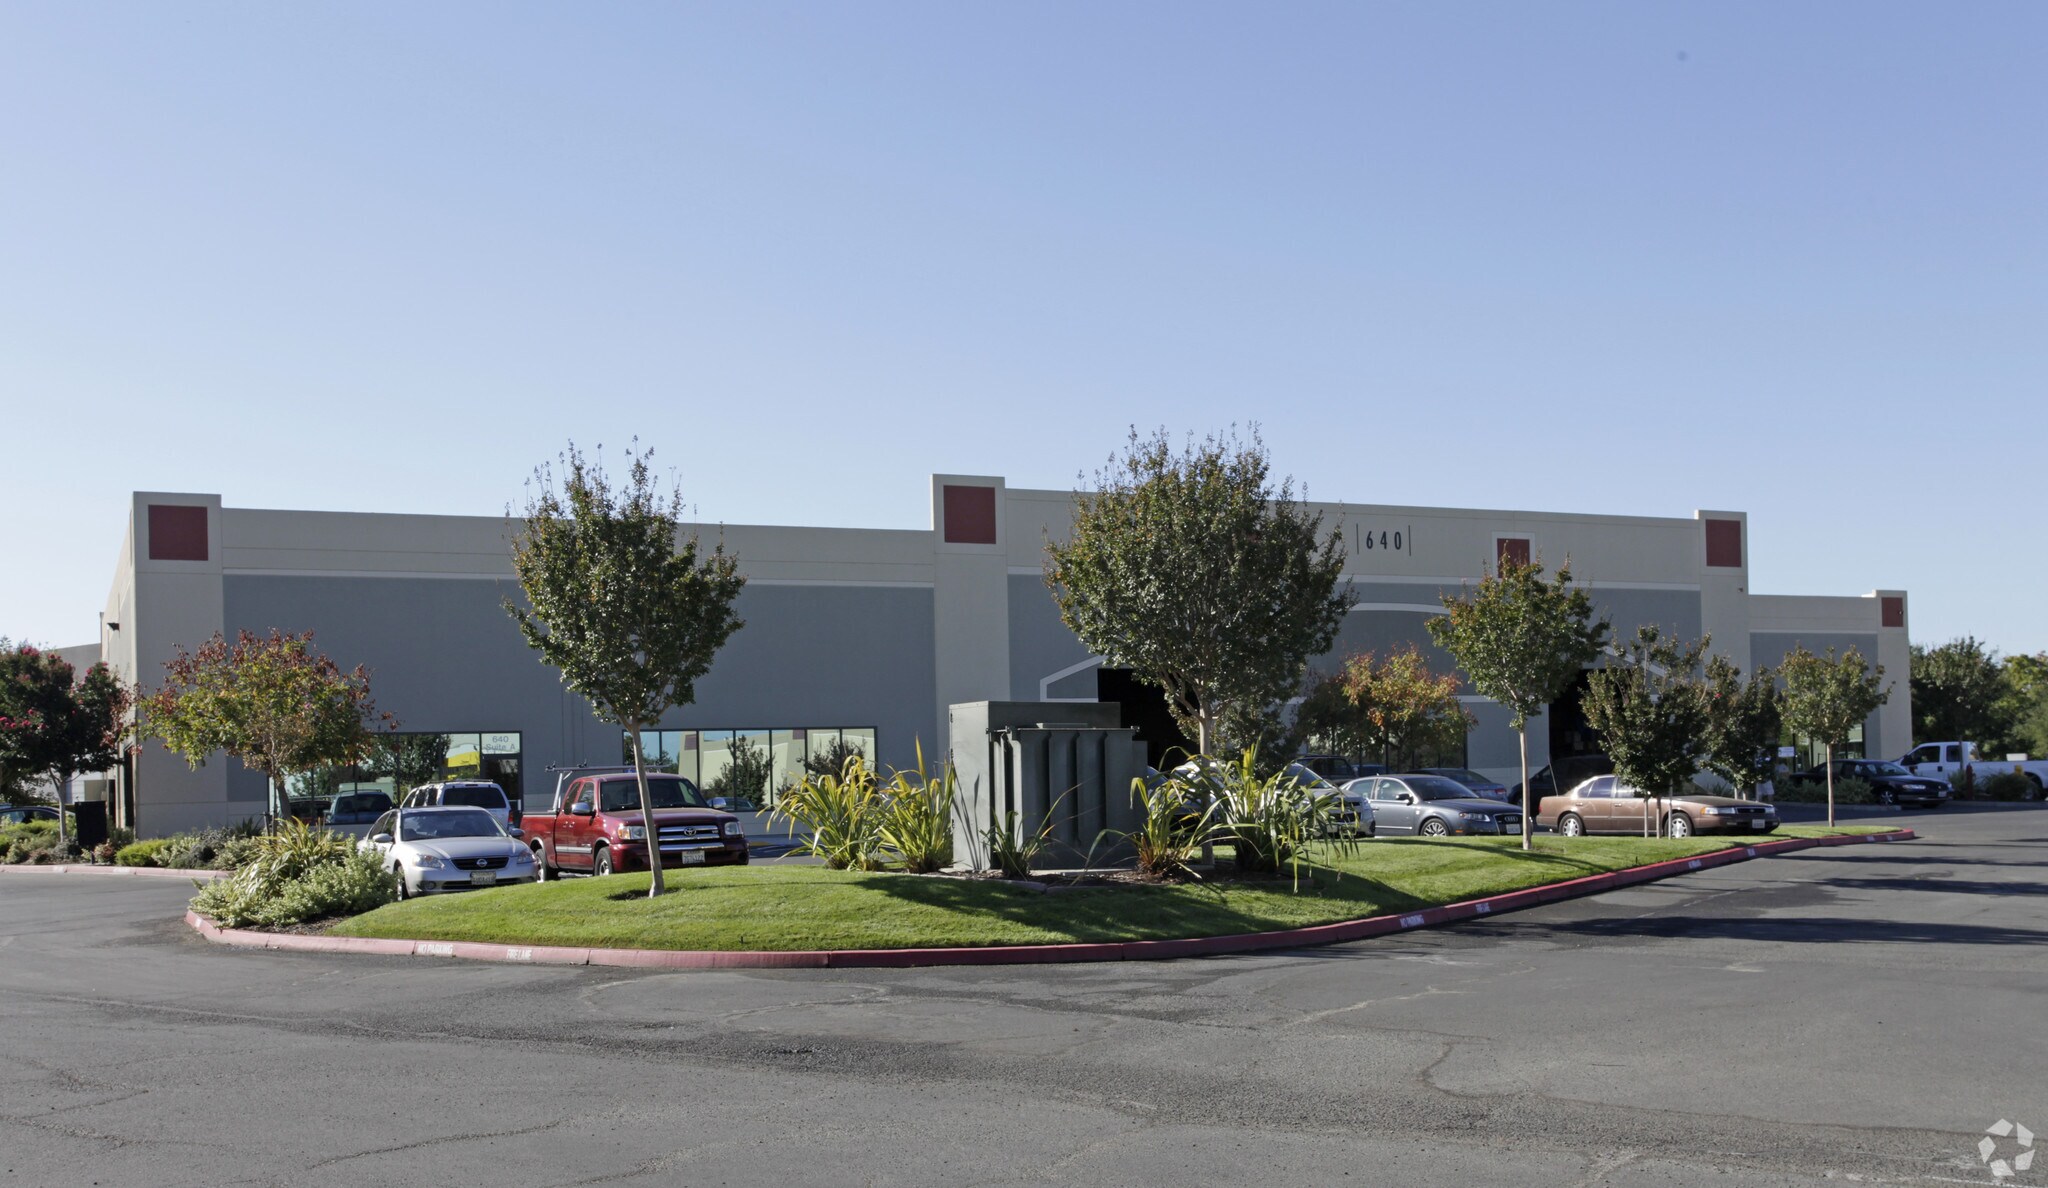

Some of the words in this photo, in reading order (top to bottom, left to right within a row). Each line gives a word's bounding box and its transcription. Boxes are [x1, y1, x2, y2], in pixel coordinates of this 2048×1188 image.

[1366, 531, 1402, 550] 640
[417, 943, 427, 954] NO
[427, 944, 454, 955] PARKING
[507, 948, 519, 960] FIRE
